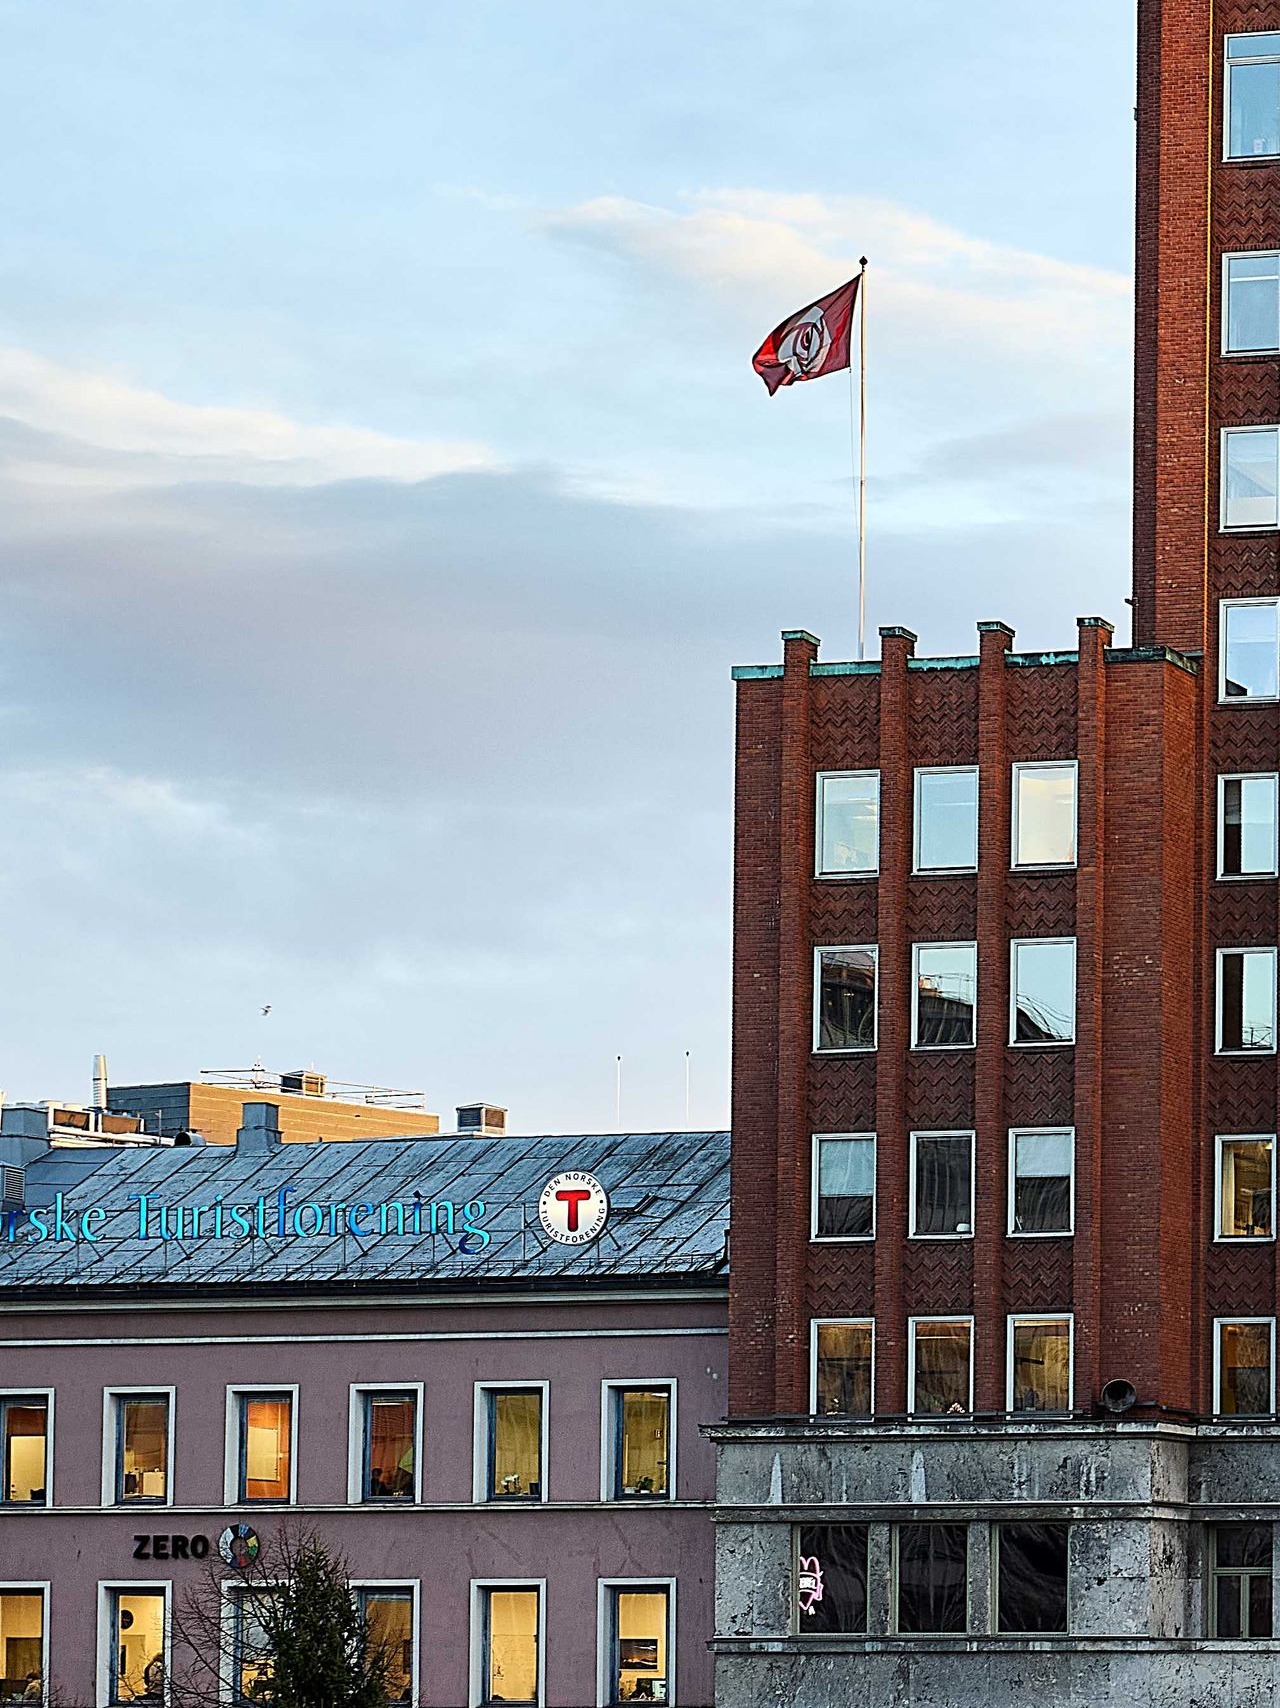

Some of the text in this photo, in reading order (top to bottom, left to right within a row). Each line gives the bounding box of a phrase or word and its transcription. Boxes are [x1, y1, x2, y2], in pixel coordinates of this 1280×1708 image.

[544, 1173, 602, 1197] DEN NORSKE
[0, 1185, 491, 1254] rske Turistforening
[541, 1208, 605, 1243] TURISTFORENING
[555, 1189, 591, 1232] T
[133, 1534, 209, 1560] ZERO
